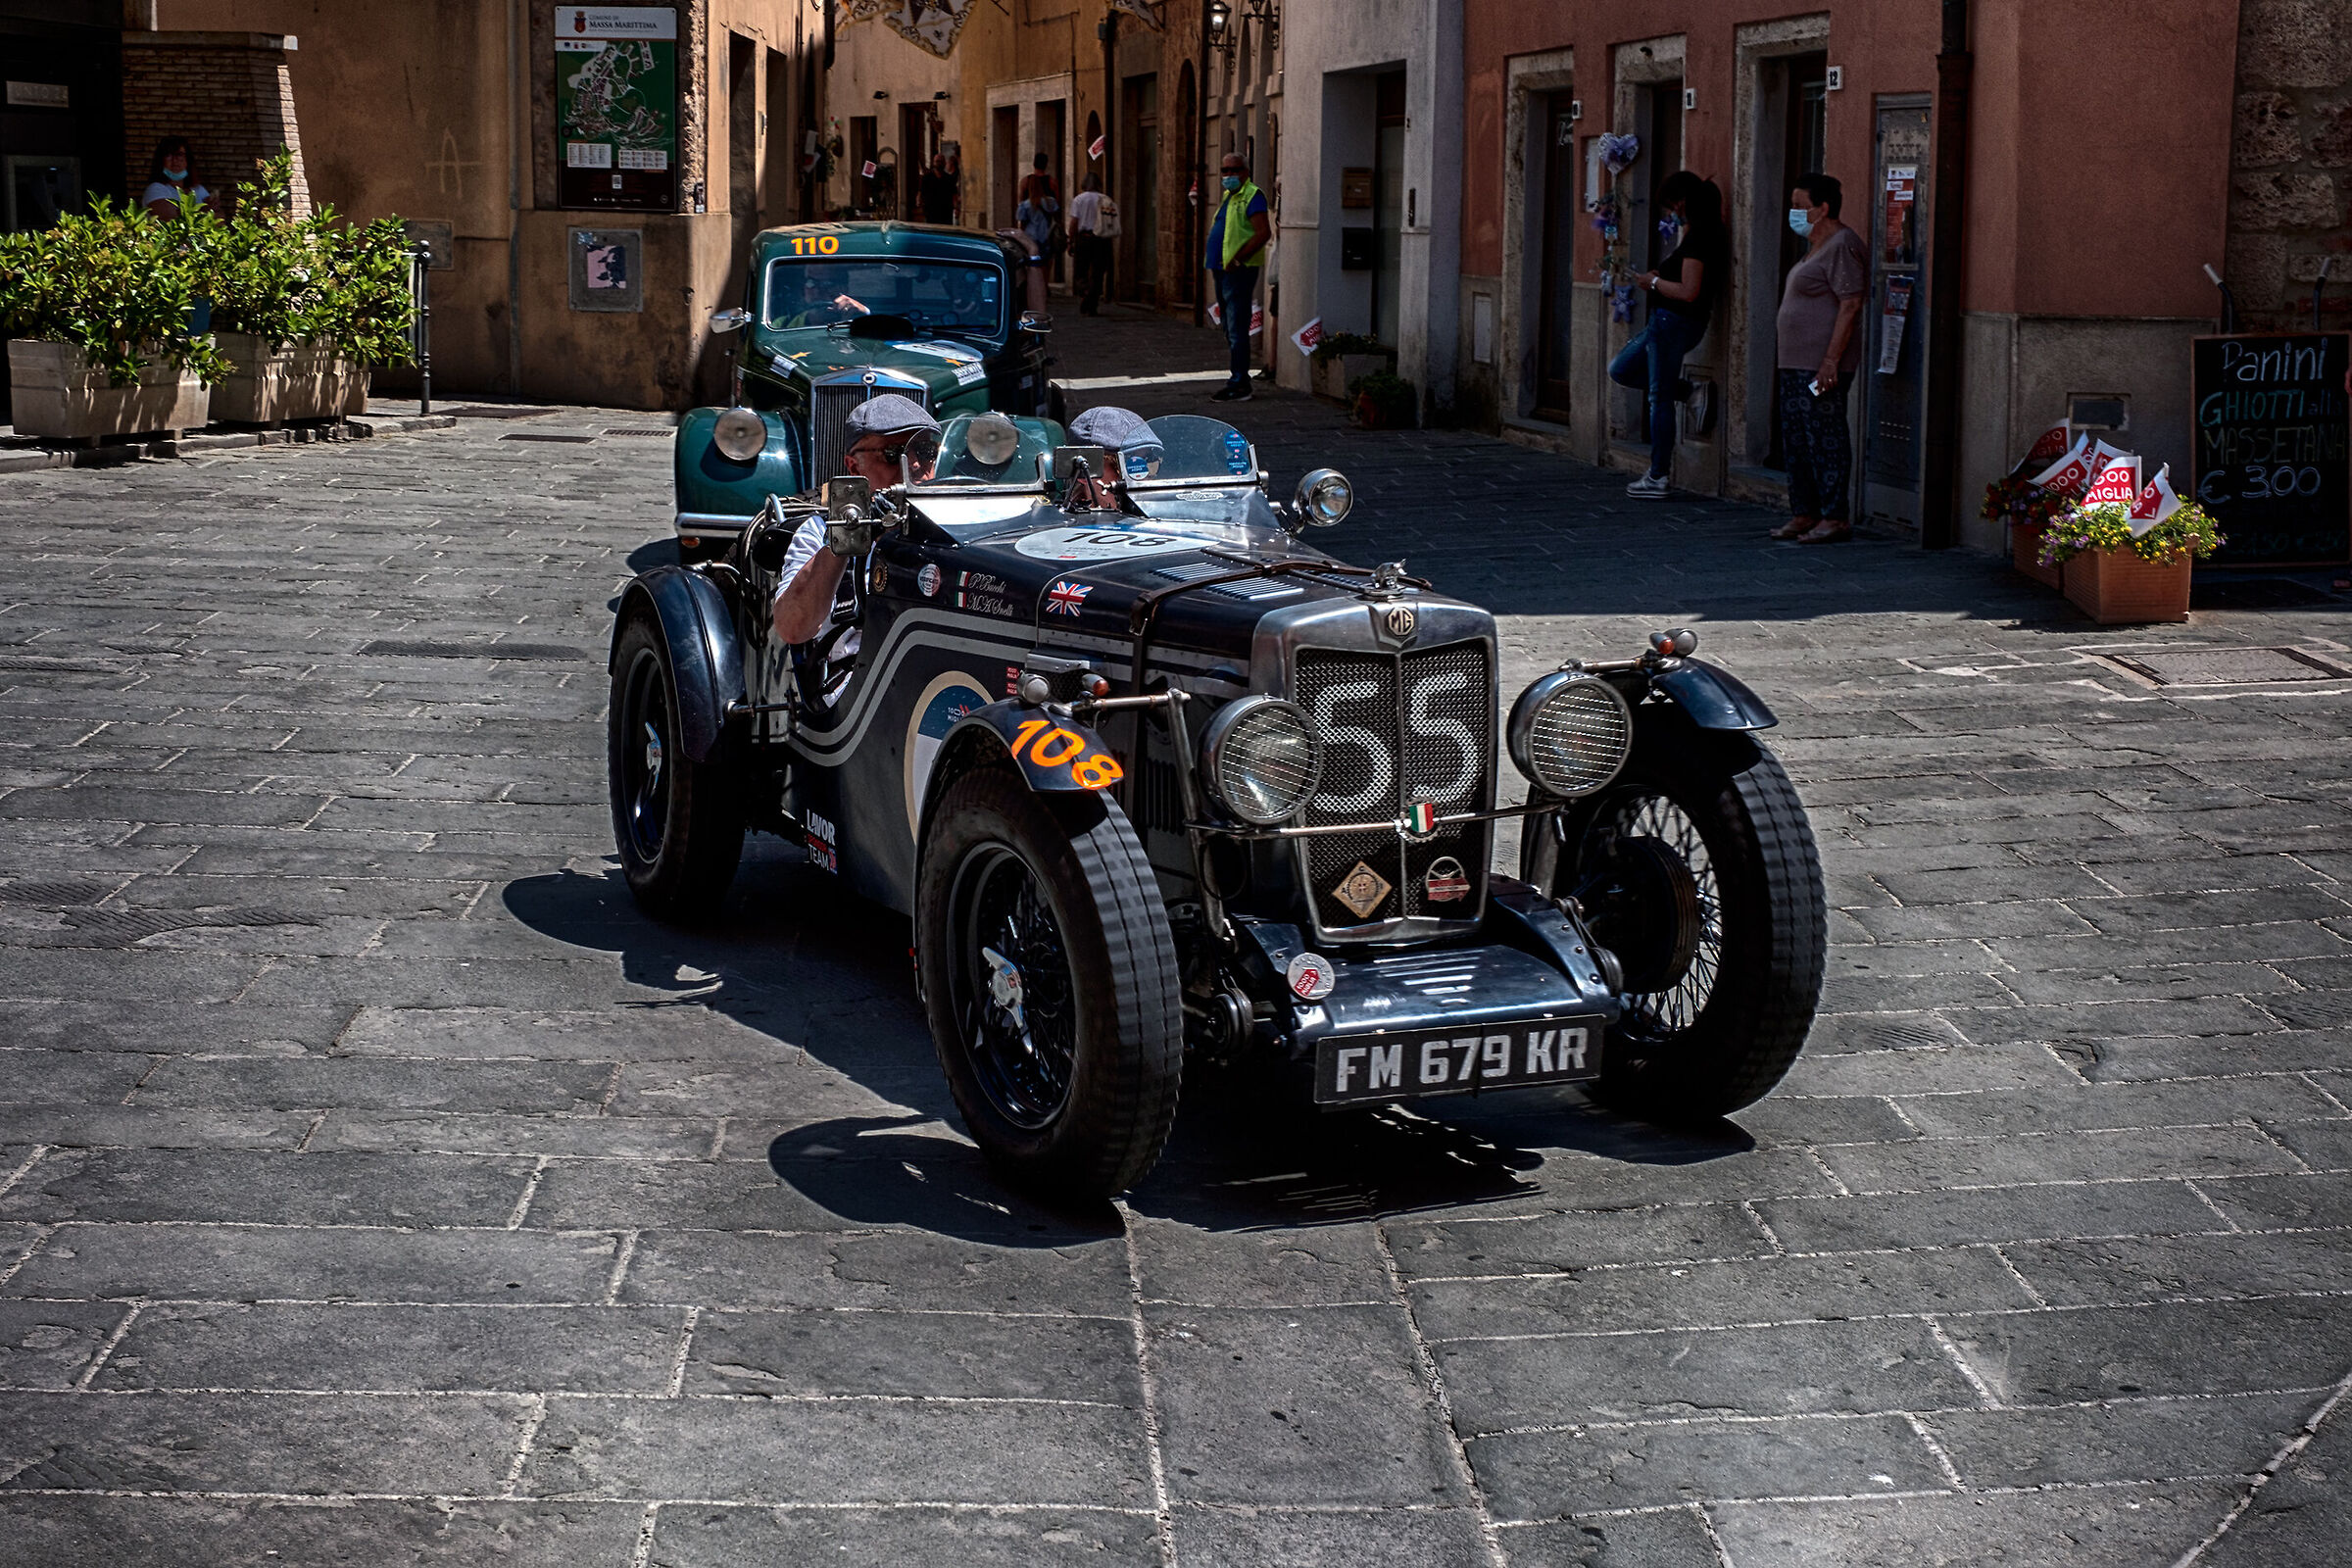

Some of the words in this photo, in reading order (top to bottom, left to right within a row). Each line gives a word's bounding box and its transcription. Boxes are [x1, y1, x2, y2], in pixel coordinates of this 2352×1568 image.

[614, 21, 658, 29] MARITTIMA
[1830, 71, 1838, 86] 12
[791, 235, 839, 255] 110
[2221, 337, 2328, 382] Panini
[2199, 389, 2305, 427] GHIOTTI
[2204, 424, 2346, 467] MASSETANA
[2085, 487, 2133, 503] MIGLIA
[2197, 469, 2231, 505] €
[1062, 531, 1178, 547] 108
[1391, 610, 1412, 633] MG
[1011, 720, 1124, 790] 108
[1313, 672, 1479, 813] 55
[807, 808, 836, 846] LAVOR
[808, 843, 829, 871] TEAM
[1296, 973, 1310, 990] 1000
[1300, 976, 1316, 996] MIGLIA
[1336, 1044, 1402, 1092] FM
[1419, 1034, 1511, 1084] 679
[1526, 1027, 1589, 1074] KR
